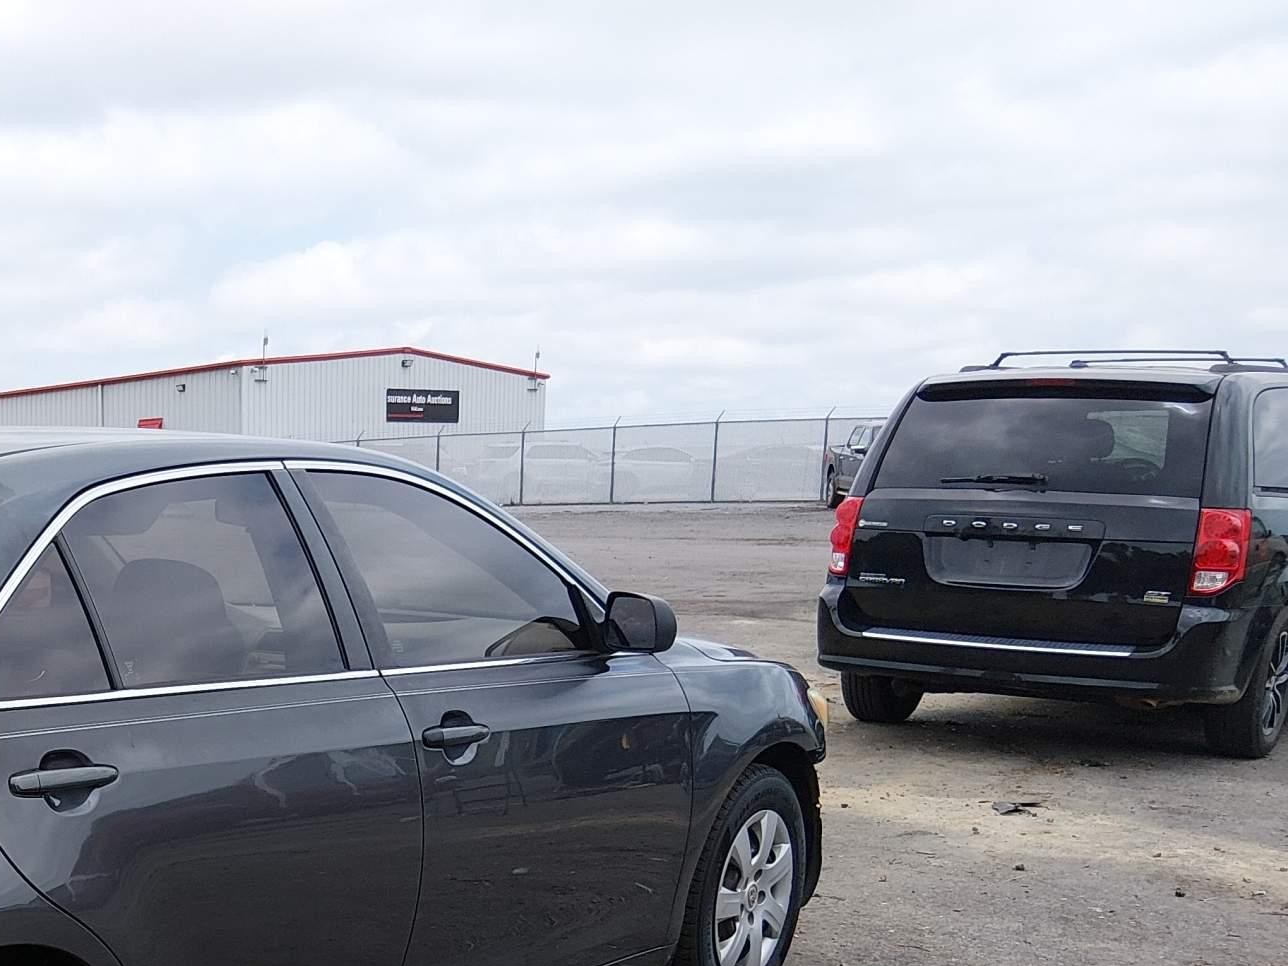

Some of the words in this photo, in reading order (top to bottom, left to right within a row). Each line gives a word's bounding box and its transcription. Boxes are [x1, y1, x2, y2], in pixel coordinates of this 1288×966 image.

[412, 394, 426, 404] Auto
[427, 394, 452, 405] Auctions
[942, 519, 1083, 531] DODGE
